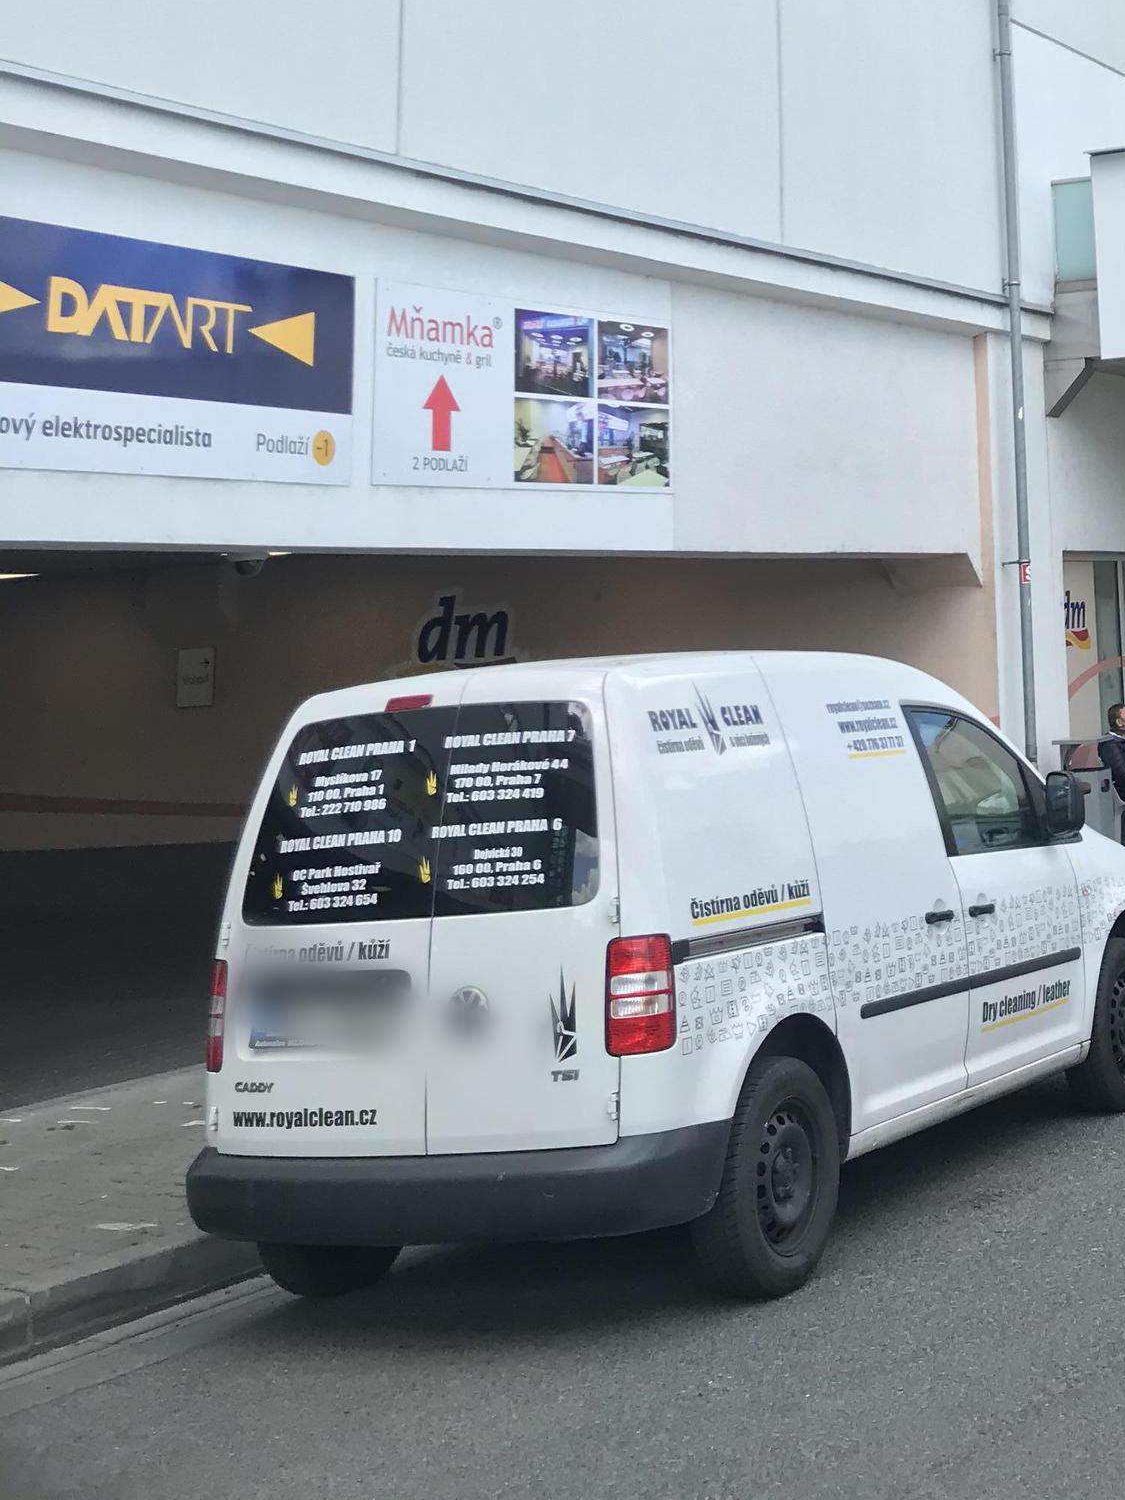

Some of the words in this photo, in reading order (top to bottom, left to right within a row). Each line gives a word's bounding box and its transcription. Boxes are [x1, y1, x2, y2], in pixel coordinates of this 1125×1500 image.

[47, 275, 253, 354] DATART
[386, 342, 416, 359] česká
[419, 347, 462, 365] kuchyně
[465, 353, 472, 364] &
[42, 414, 213, 448] elektrospecialista
[256, 432, 310, 456] Podlaží
[412, 456, 419, 470] 2
[423, 456, 468, 472] PODLAŽÍ
[416, 594, 510, 664] dm
[647, 708, 698, 732] ROYAL
[720, 704, 764, 726] CLEAN
[444, 734, 480, 748] ROYAL
[482, 732, 521, 746] CLEAN
[522, 730, 565, 743] PRAHA
[567, 730, 576, 742] 7
[298, 748, 330, 765] ROYAL
[331, 744, 365, 760] CLEAN
[365, 740, 404, 756] PRAHA
[409, 739, 417, 752] 1
[370, 769, 383, 781] 17
[454, 777, 473, 788] 170
[495, 774, 532, 786] Praha
[534, 774, 542, 784] 7
[307, 790, 324, 802] 110
[344, 785, 376, 798] Praha
[378, 784, 385, 795] 1
[471, 789, 495, 801] 603
[497, 788, 520, 800] 324
[522, 787, 544, 798] 419
[321, 803, 342, 816] 222
[343, 801, 362, 813] 710
[363, 799, 387, 811] 986
[431, 824, 466, 839] ROYAL
[468, 821, 505, 836] CLEAN
[506, 818, 548, 833] PRAHA
[552, 817, 562, 831] 6
[280, 838, 311, 854] ROYAL
[312, 834, 346, 850] CLEAN
[347, 830, 385, 846] PRAHA
[387, 828, 402, 843] 10
[510, 846, 523, 857] 30
[292, 870, 307, 881] OC
[308, 867, 332, 880] Park
[334, 861, 381, 877] Hostivař
[452, 864, 474, 875] 160
[495, 861, 531, 872] Praha
[532, 859, 542, 870] 6
[300, 881, 350, 895] Švehlova
[351, 879, 367, 891] 32
[471, 876, 495, 888] 603
[496, 875, 519, 887] 324
[521, 873, 545, 885] 254
[310, 897, 331, 910] 603
[333, 895, 354, 908] 324
[355, 893, 378, 906] 654
[690, 895, 740, 920] Čistírna
[743, 884, 778, 909] oděvů
[787, 879, 810, 900] kůží
[347, 942, 355, 962] /
[358, 938, 391, 960] kůží
[982, 1002, 998, 1023] Dry
[999, 990, 1036, 1017] cleaning
[1042, 979, 1070, 1004] leather
[551, 1069, 580, 1082] TSI
[234, 1082, 274, 1093] CADDY
[233, 1108, 377, 1130] www.royalclean.cz
